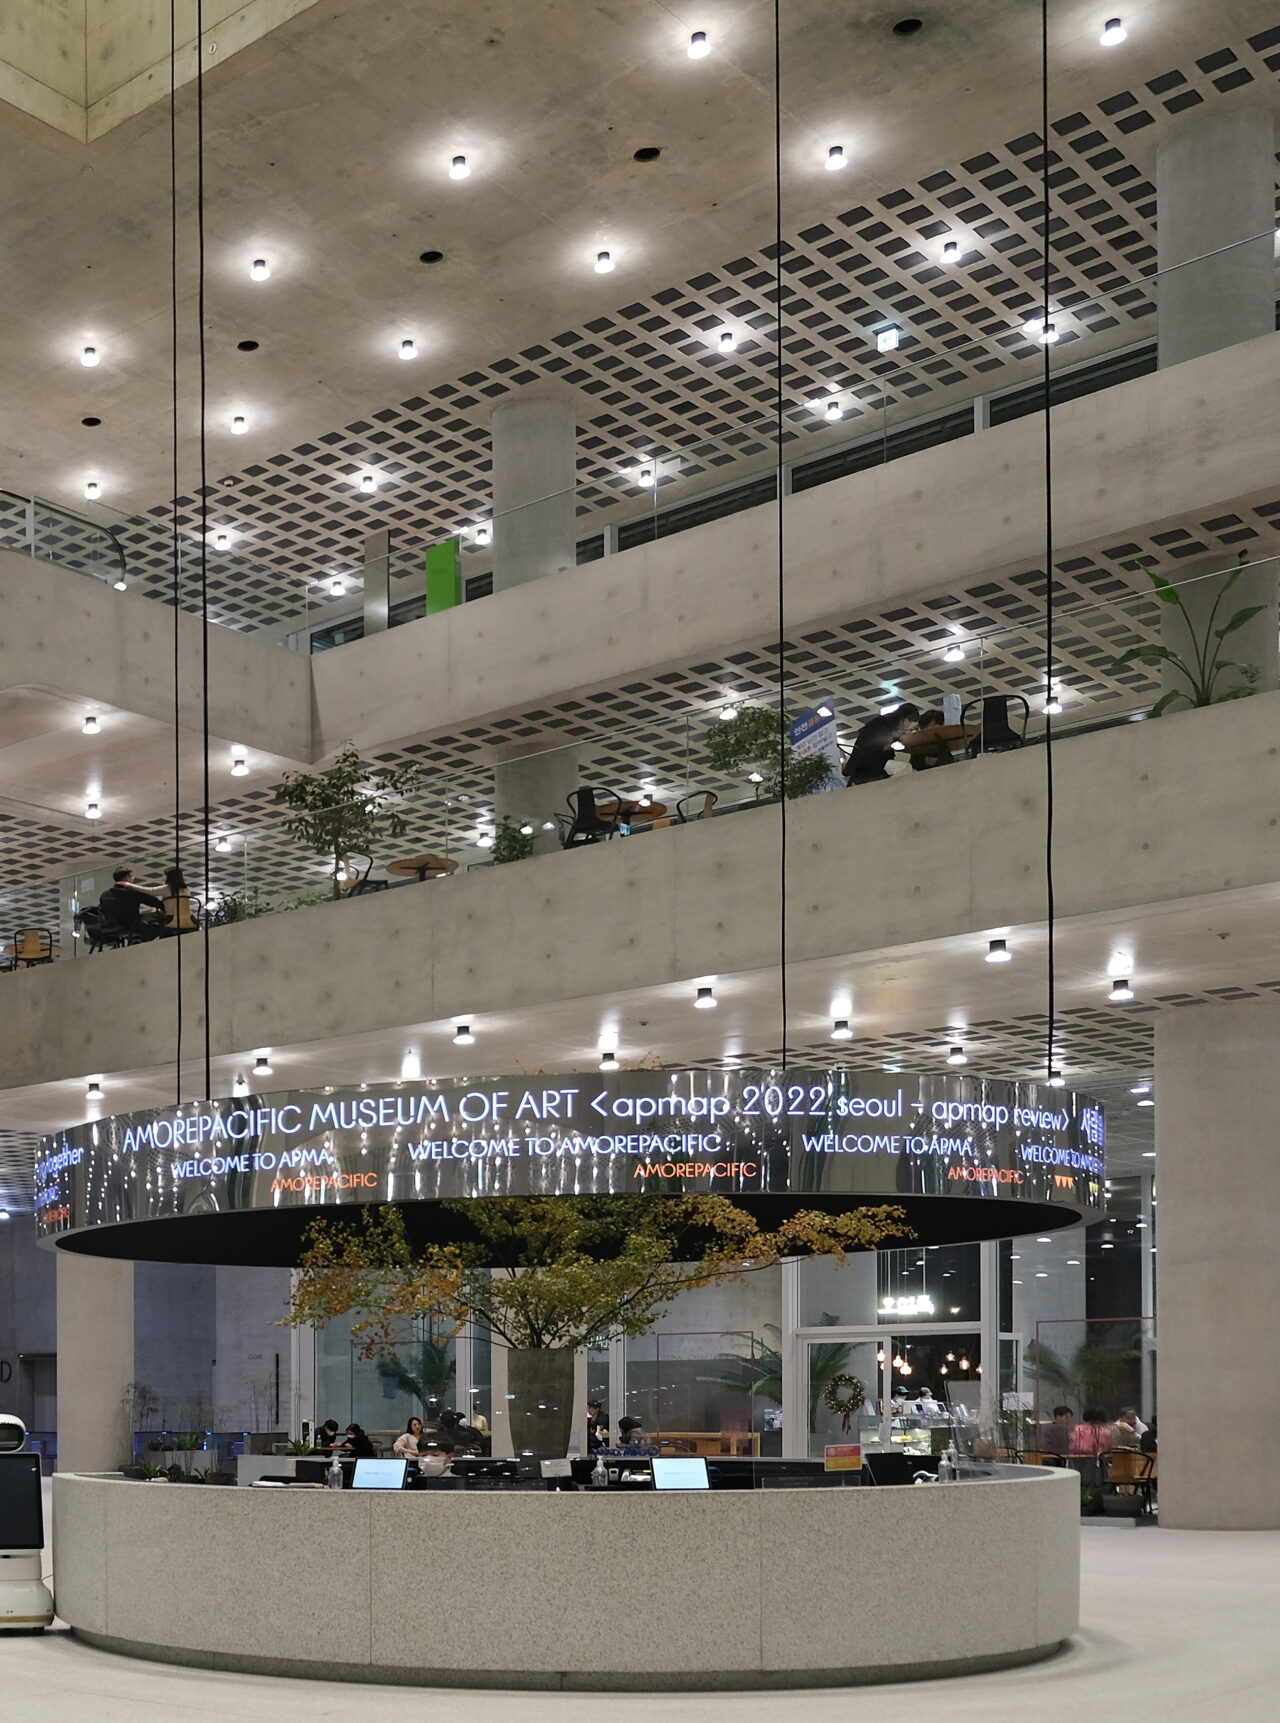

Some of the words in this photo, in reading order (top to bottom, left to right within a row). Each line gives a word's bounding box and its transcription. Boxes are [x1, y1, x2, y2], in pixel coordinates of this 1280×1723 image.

[122, 1104, 302, 1154] AMOREPACIFIC
[309, 1094, 450, 1131] MUSEUM
[459, 1091, 509, 1122] OF
[515, 1088, 580, 1120] ART
[742, 1085, 826, 1116] 2022
[836, 1088, 903, 1118] seoul
[931, 1101, 1009, 1131] apmap
[407, 1138, 520, 1160] WELCOME
[525, 1136, 555, 1156] TO
[560, 1133, 722, 1155] AMOREPACIFIC
[801, 1133, 900, 1154] WELCOME
[903, 1135, 925, 1154] TO
[929, 1136, 972, 1157] APMA
[1021, 1143, 1070, 1167] WELCOME
[170, 1154, 250, 1179] WELCOME
[253, 1152, 276, 1171] TO
[279, 1148, 333, 1169] APMA
[633, 1162, 757, 1179] AMOREPACIFIC
[948, 1166, 1024, 1185] AMOREPACIFIC
[270, 1172, 379, 1193] AMOREPACIFIC
